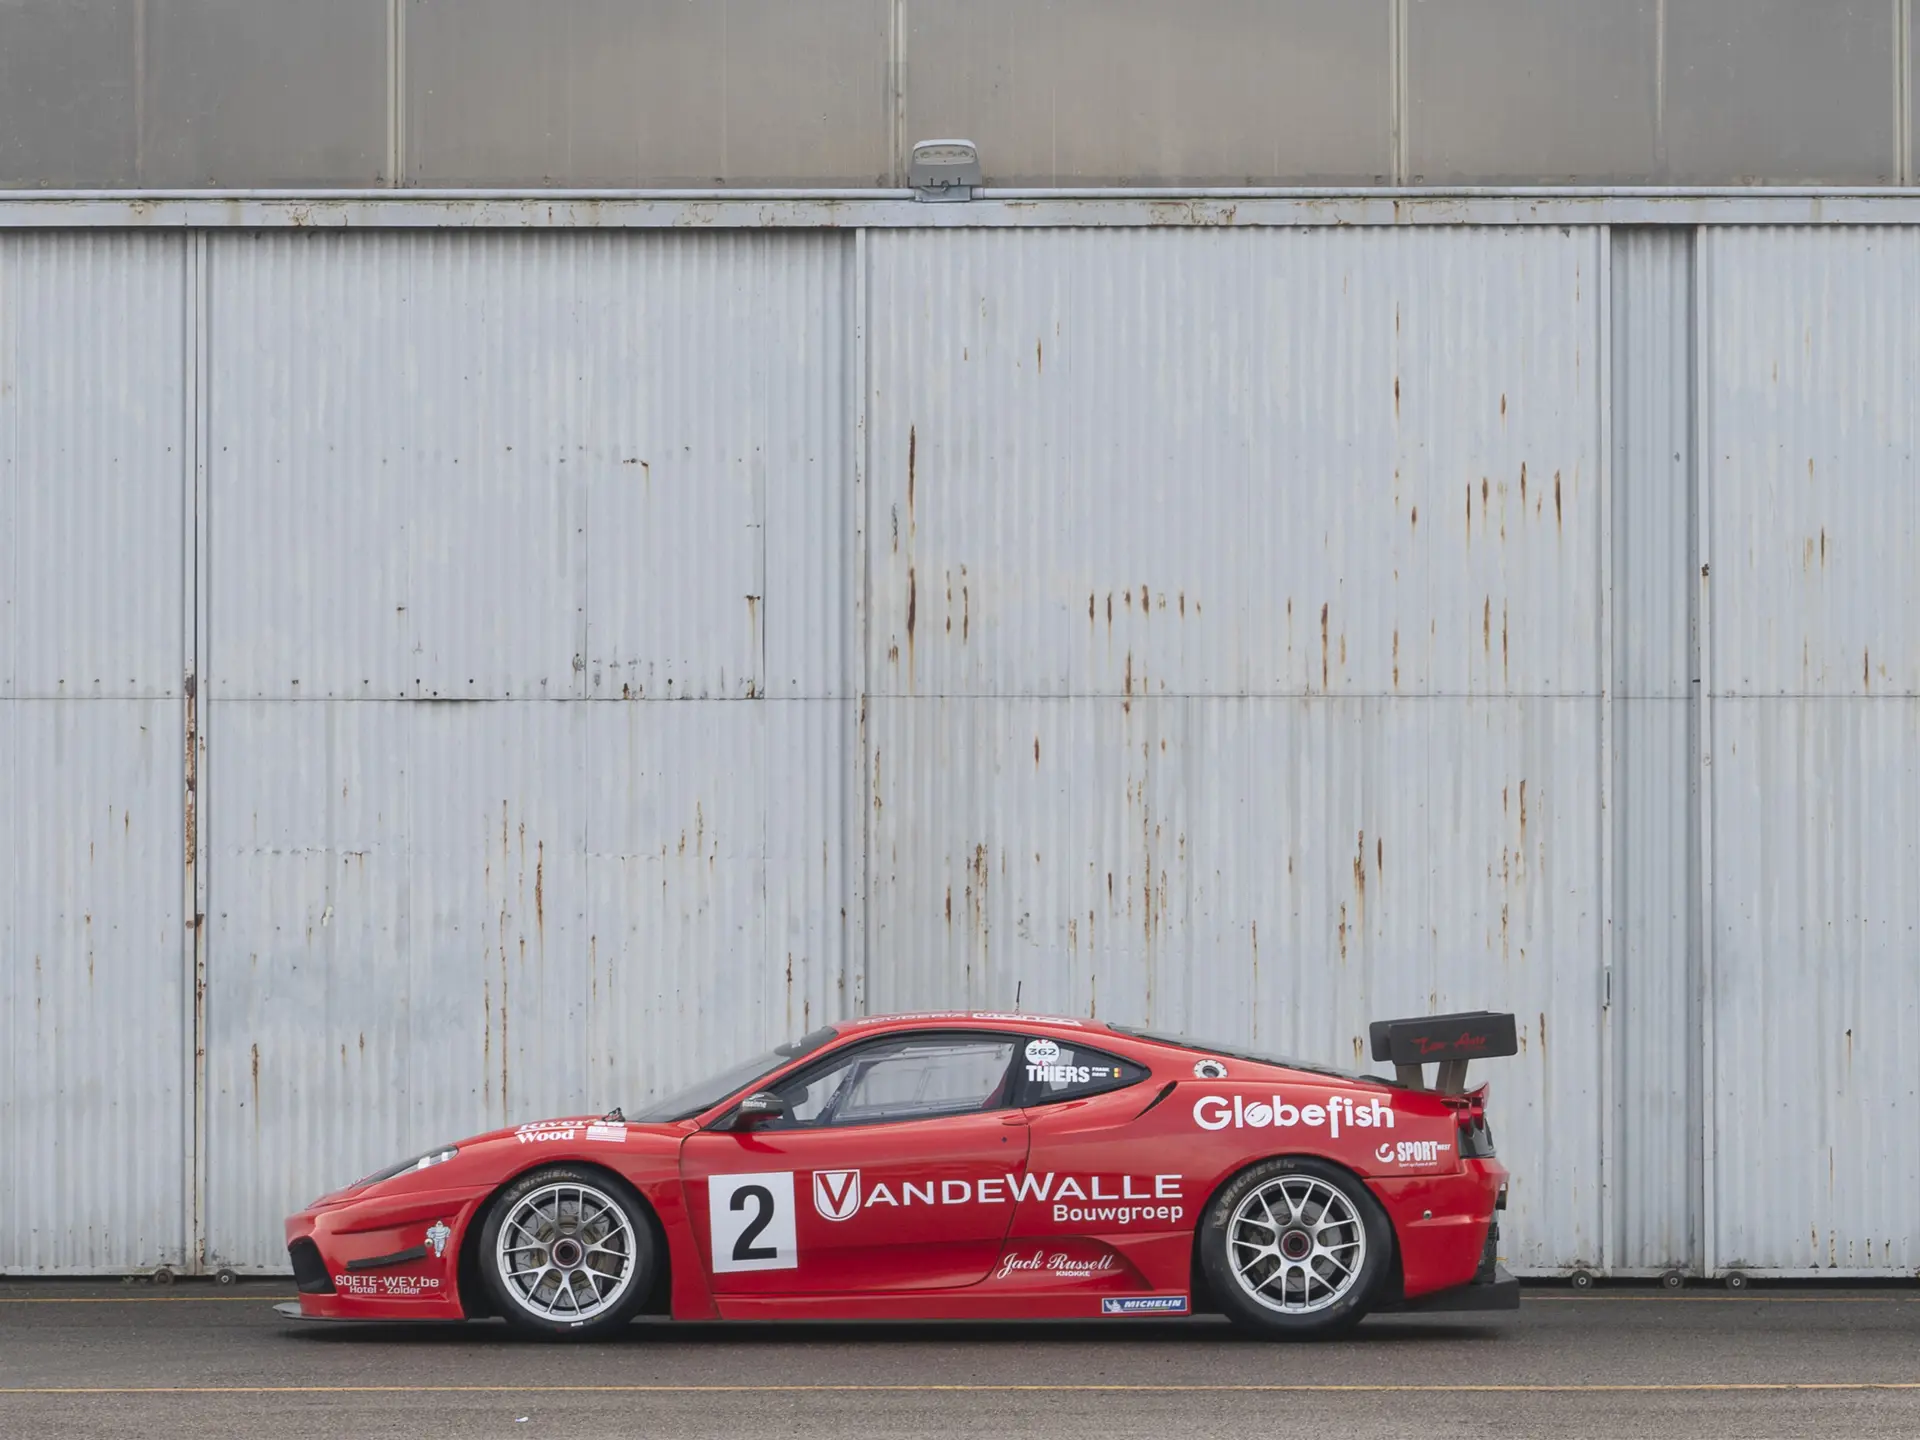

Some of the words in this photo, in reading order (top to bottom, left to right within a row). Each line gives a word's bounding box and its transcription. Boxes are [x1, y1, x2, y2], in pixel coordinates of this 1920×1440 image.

[1028, 1048, 1057, 1057] 362
[1026, 1065, 1090, 1083] THIERS
[1193, 1095, 1395, 1138] Globefish
[517, 1129, 575, 1144] Wood
[1396, 1141, 1438, 1162] SPORT
[729, 1185, 778, 1261] 2
[1053, 1204, 1184, 1224] Bouwgroep
[997, 1250, 1044, 1279] Jack
[1047, 1253, 1114, 1270] Russell
[335, 1275, 439, 1287] SOETE-WEY.be
[350, 1285, 377, 1294] Hotel
[387, 1286, 421, 1294] Zolder
[1124, 1299, 1182, 1309] MICHELIN
